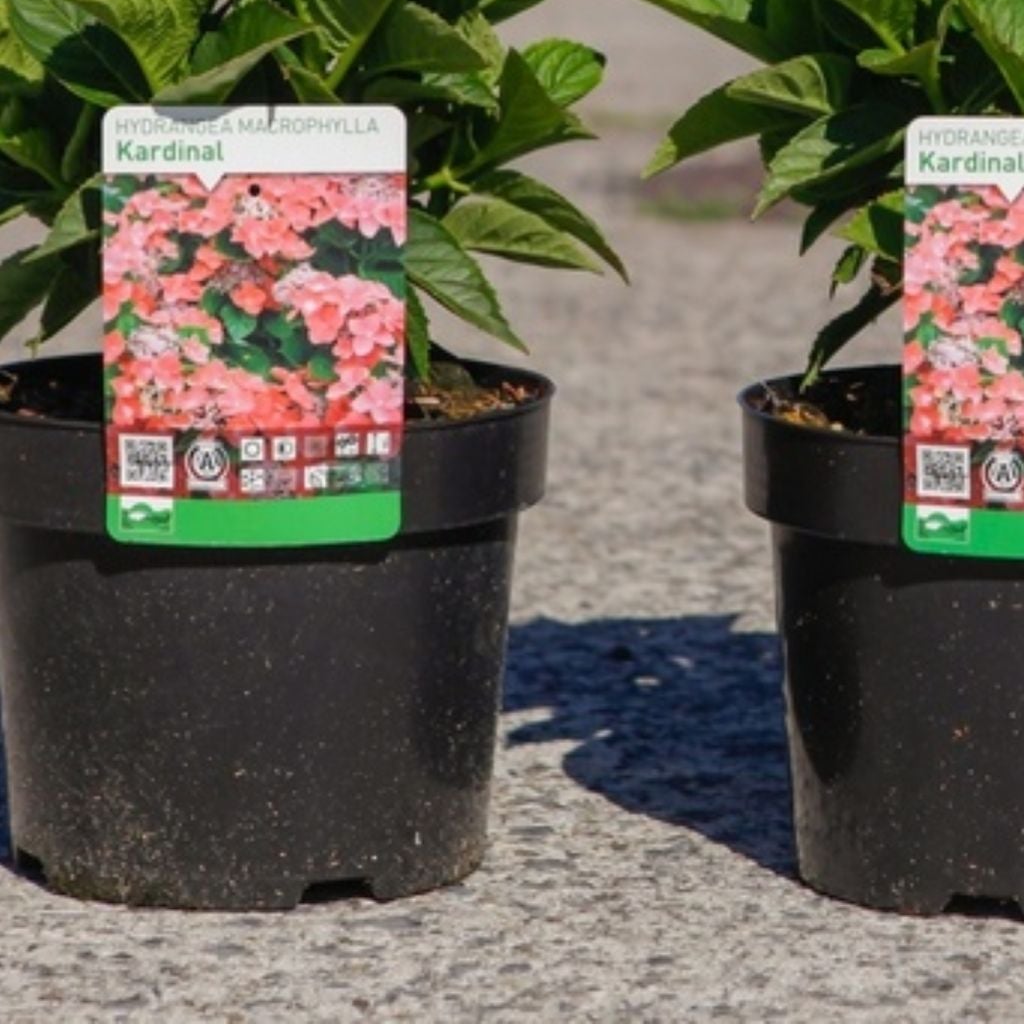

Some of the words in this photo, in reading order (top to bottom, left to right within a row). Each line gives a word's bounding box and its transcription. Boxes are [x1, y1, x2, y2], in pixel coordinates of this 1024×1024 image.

[238, 117, 380, 135] MACROPHYLLA
[116, 140, 224, 162] Kardinal
[918, 151, 1024, 173] Kardinal
